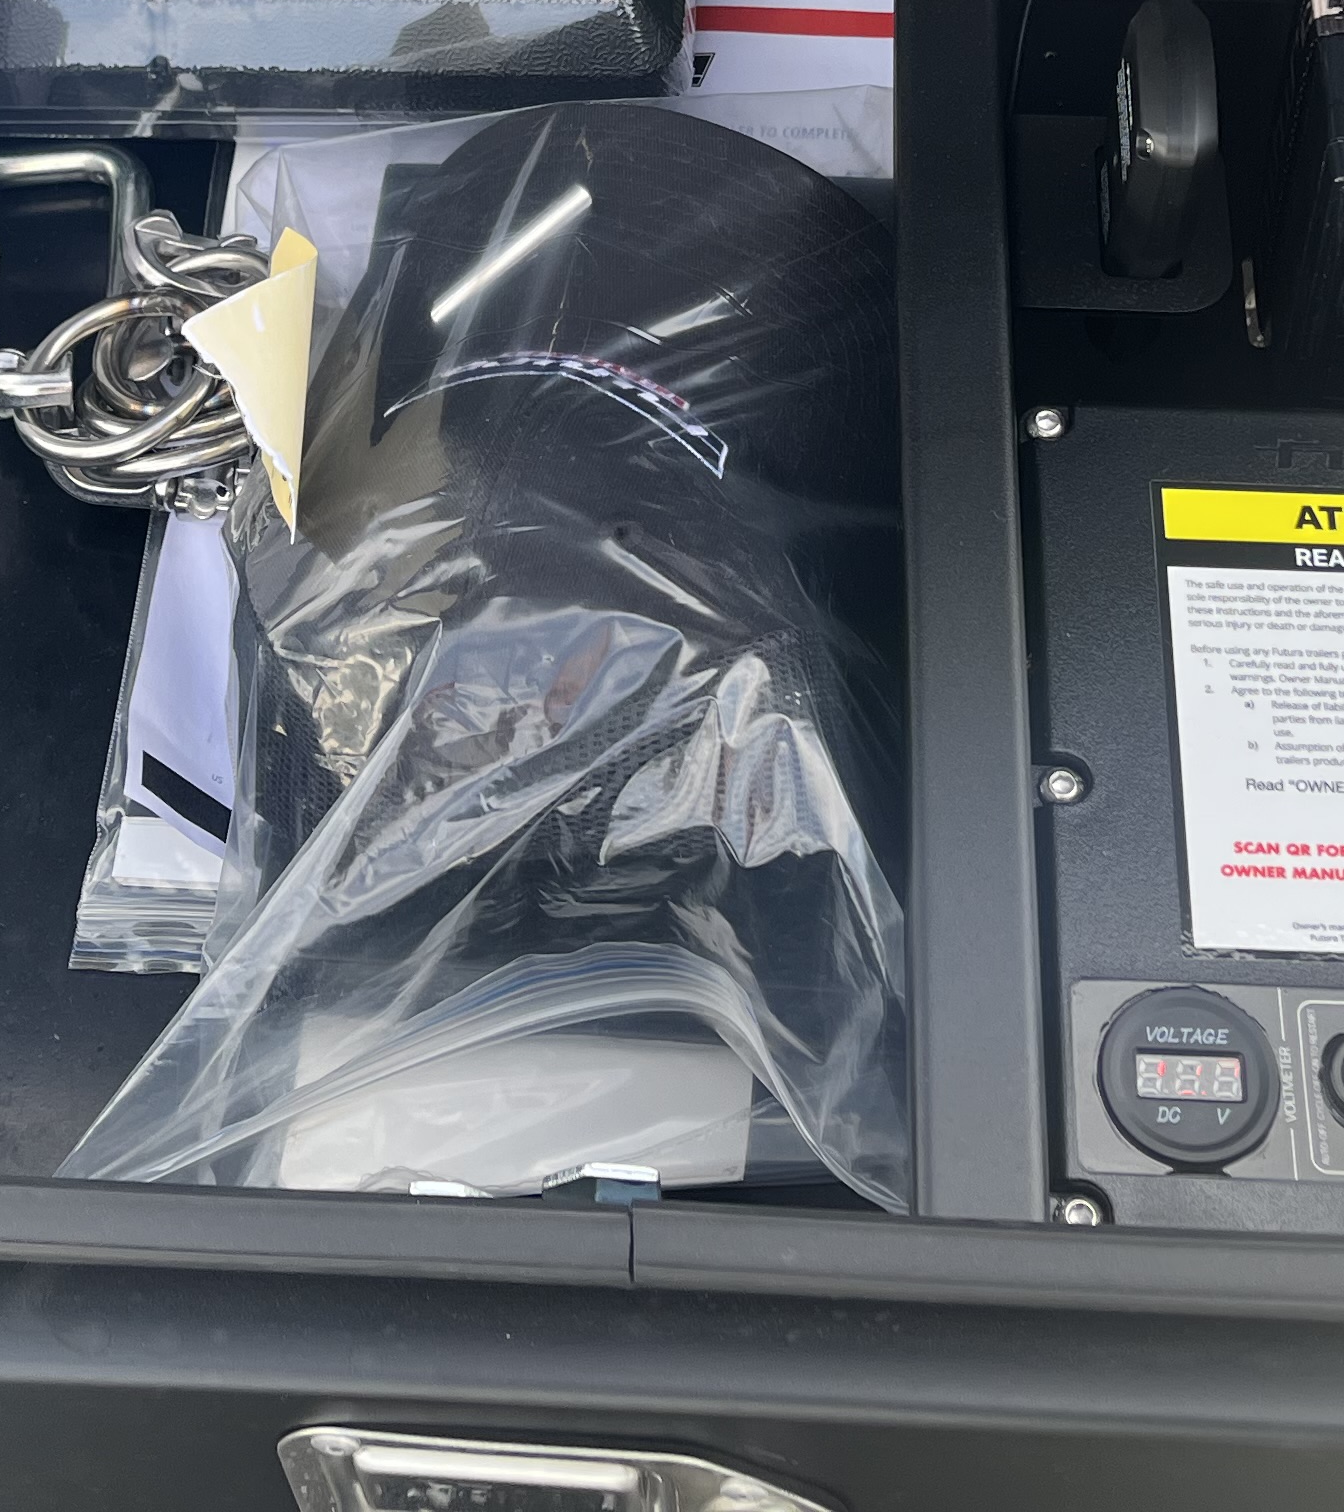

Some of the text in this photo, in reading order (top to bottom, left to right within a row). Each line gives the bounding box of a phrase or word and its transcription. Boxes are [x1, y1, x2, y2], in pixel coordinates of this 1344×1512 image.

[1245, 777, 1284, 791] Read
[1233, 840, 1281, 857] SCAN
[1286, 841, 1315, 859] QR
[1220, 865, 1287, 881] OWNER
[1146, 1026, 1230, 1045] VOLTAGE
[1277, 1045, 1298, 1124] VOLTMETER
[1156, 1106, 1182, 1124] DC
[1216, 1107, 1232, 1125] V
